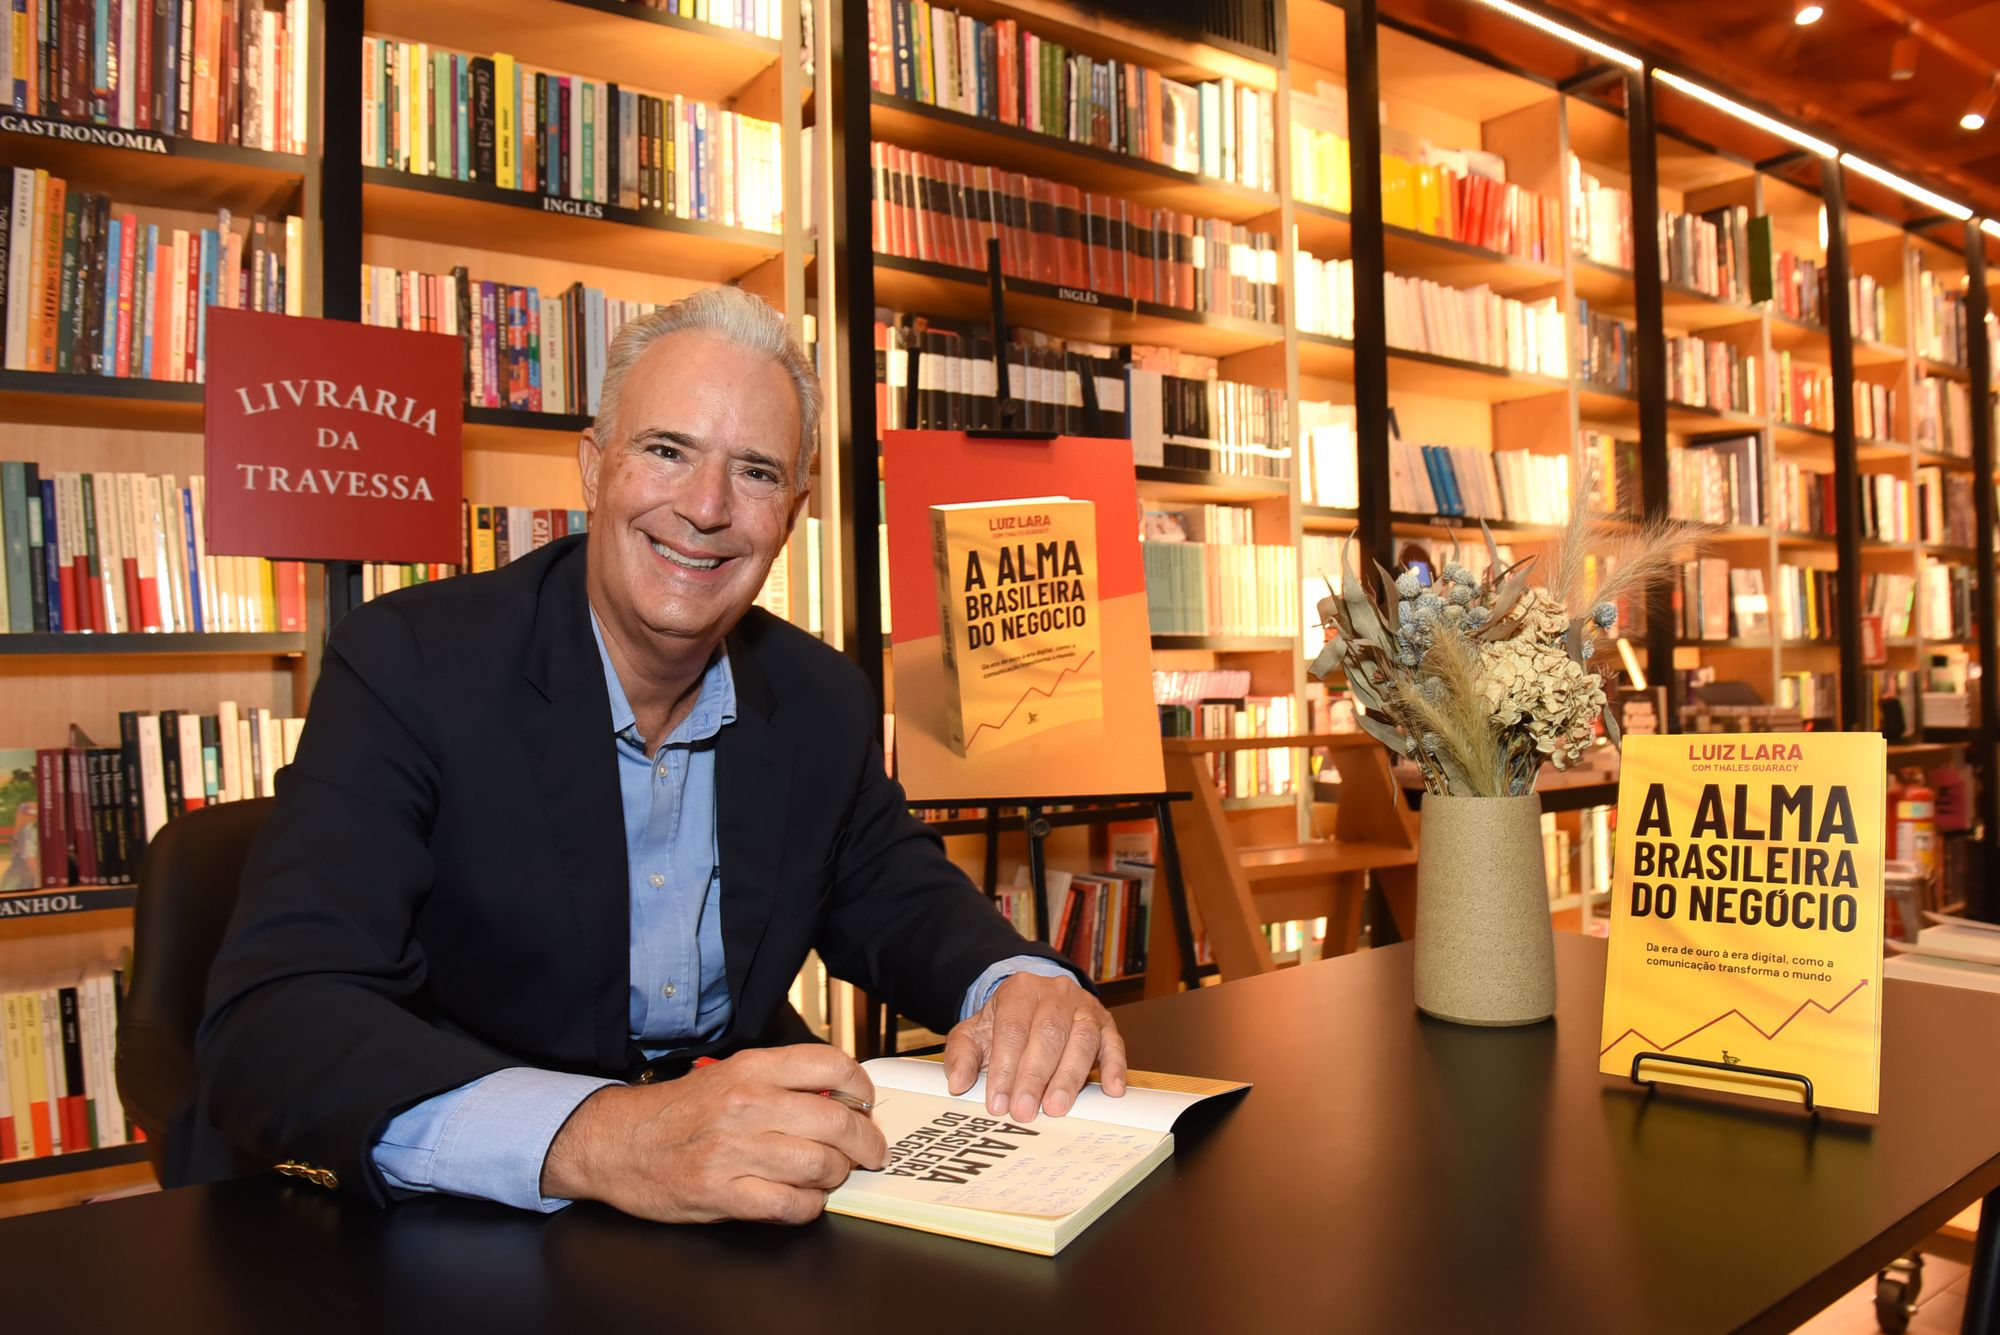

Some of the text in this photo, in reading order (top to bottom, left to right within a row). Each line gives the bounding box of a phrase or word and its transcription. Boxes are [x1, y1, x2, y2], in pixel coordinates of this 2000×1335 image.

[0, 115, 168, 154] GASTRONOMIA
[543, 197, 604, 219] INGLÊS
[235, 379, 437, 436] LIVRARIA
[317, 427, 360, 450] DA
[236, 463, 434, 501] TRAVESSA
[989, 514, 1051, 532] LUIZ LARA
[965, 550, 986, 592] A
[997, 540, 1084, 587] ALMA
[965, 579, 1086, 622] BRASILEIRA
[968, 621, 995, 650] DO
[1002, 605, 1086, 642] NEGÓCIO
[1689, 743, 1803, 761] LUIZ LARA
[1692, 763, 1799, 773] COM THALES GUARACY
[1635, 783, 1859, 845] A ALMA
[1633, 841, 1859, 888] BRASILEIRA
[1630, 881, 1858, 933] DO NEGÓCIO
[1646, 942, 1834, 968] Da era de ouro à era digital, como a
[1646, 957, 1832, 983] comunicação transforma o mundo
[931, 1111, 972, 1127] DO
[884, 1117, 1001, 1177] BRASILEIRA
[915, 1122, 1041, 1185] A ALMA
